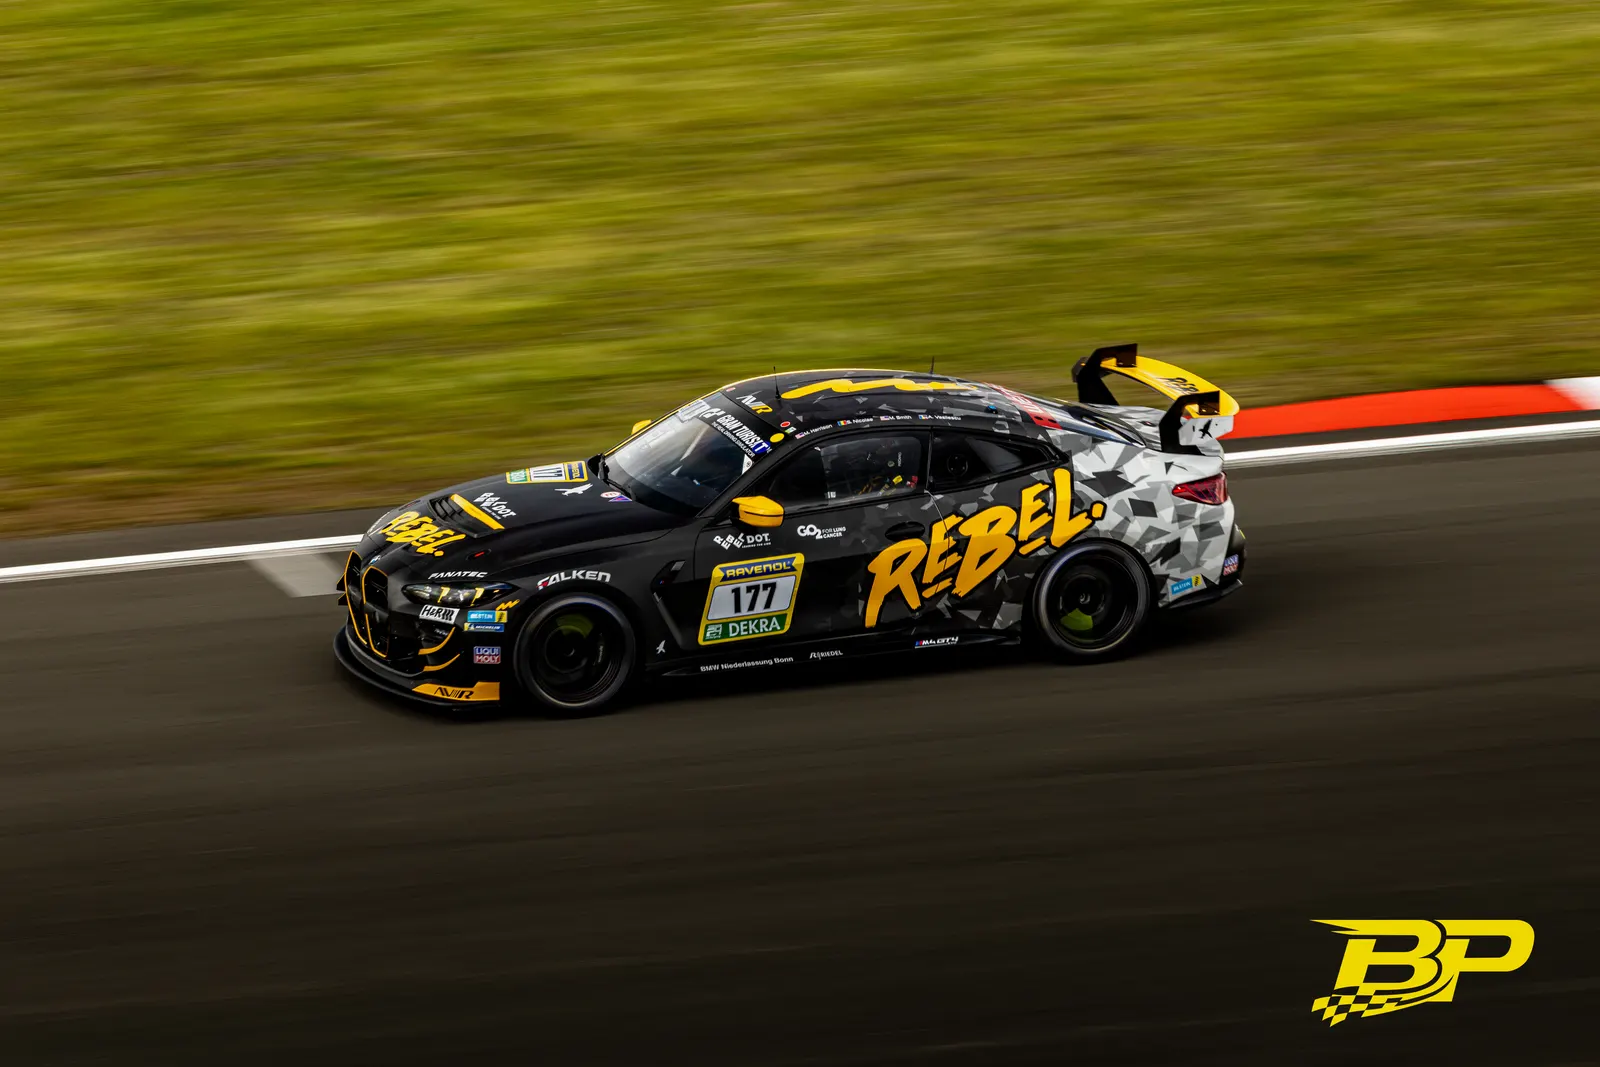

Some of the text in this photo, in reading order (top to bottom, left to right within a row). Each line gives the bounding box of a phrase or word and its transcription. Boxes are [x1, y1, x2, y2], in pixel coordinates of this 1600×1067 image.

[427, 570, 488, 580] FANATEC
[536, 568, 611, 591] FALKEN
[732, 582, 777, 614] 177
[729, 616, 780, 637] DEKRA
[475, 655, 500, 663] MOLY
[700, 664, 719, 672] BMW
[721, 659, 773, 669] Niederlassung
